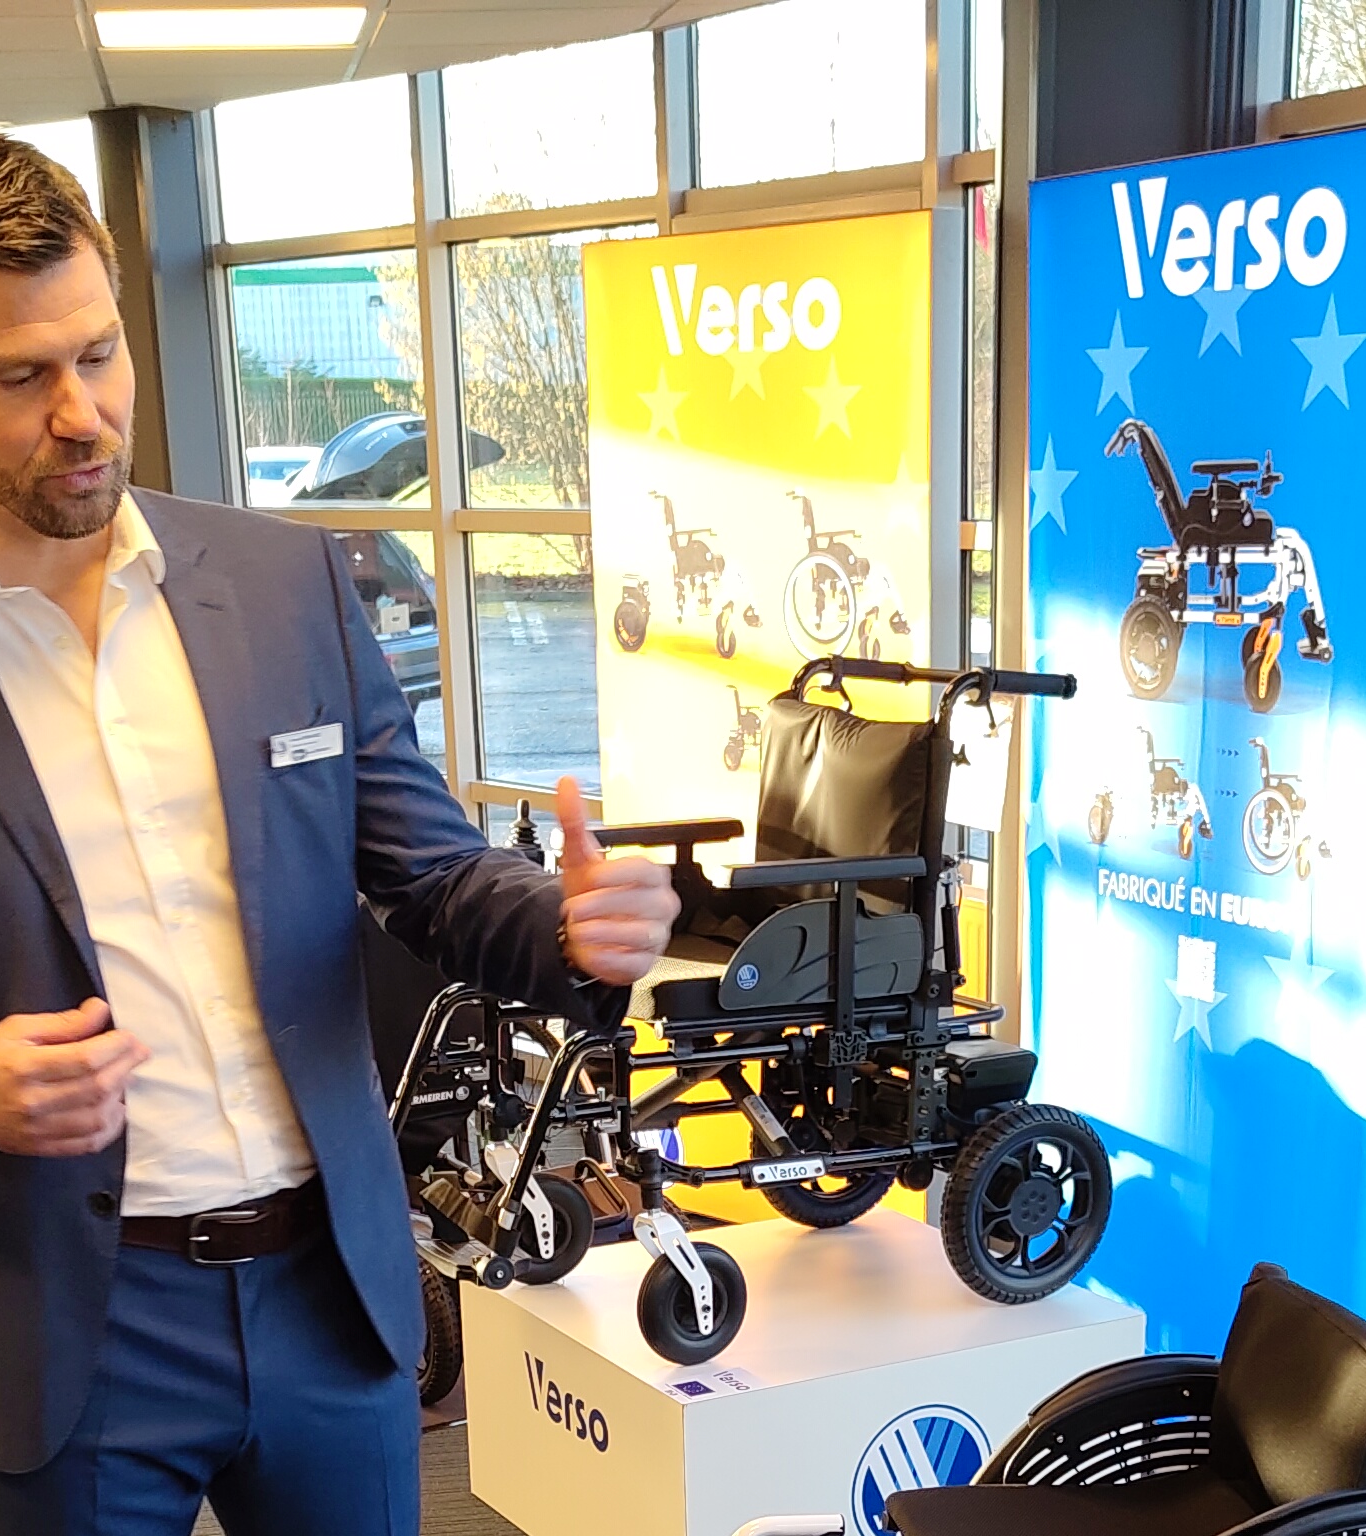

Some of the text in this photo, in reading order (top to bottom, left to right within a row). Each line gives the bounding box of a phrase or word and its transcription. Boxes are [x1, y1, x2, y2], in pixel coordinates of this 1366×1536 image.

[1111, 176, 1347, 299] Verso
[651, 264, 841, 356] Verso
[1098, 868, 1185, 912] FABRIQUÉ
[1191, 886, 1216, 918] EN
[411, 1090, 454, 1106] RMEIREN
[768, 1166, 808, 1179] Verso
[524, 1351, 609, 1453] Verso
